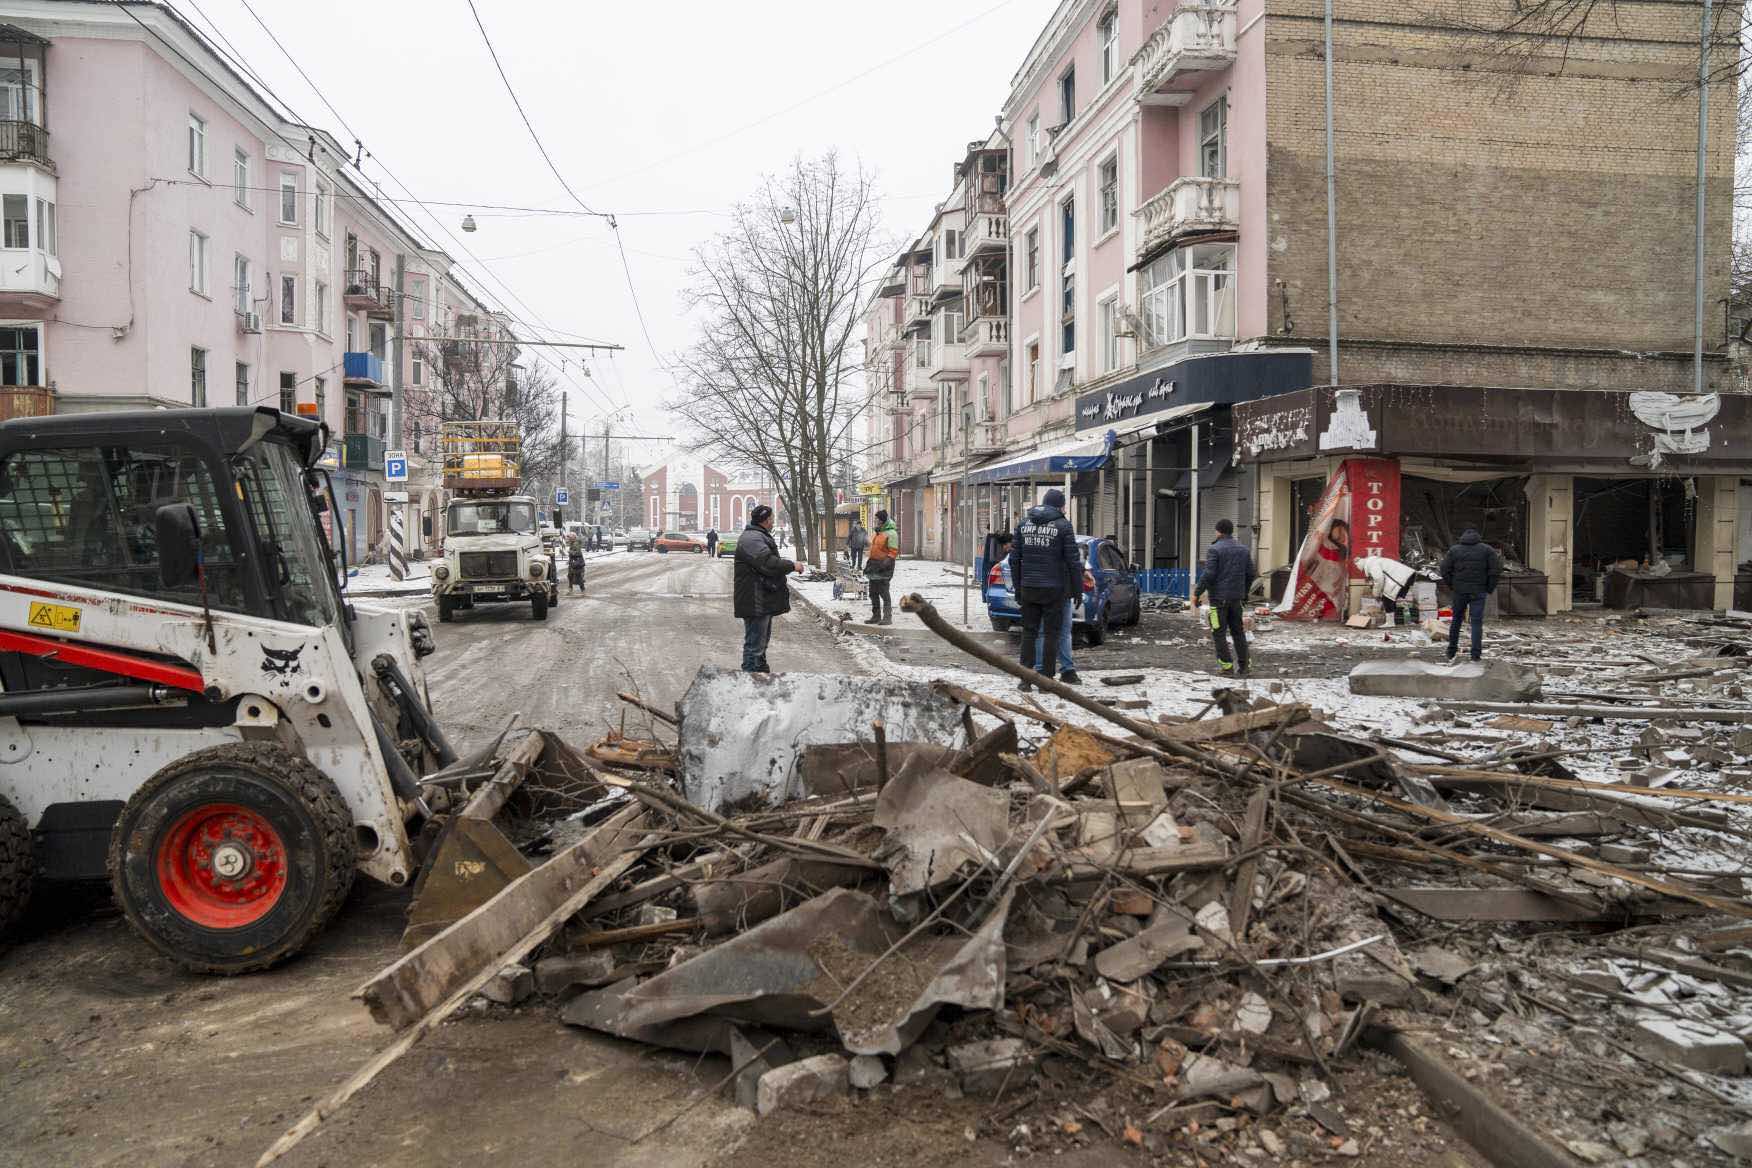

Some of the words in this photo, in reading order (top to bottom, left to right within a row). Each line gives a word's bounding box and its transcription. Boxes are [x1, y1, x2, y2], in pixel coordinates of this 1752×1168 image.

[392, 463, 401, 475] P
[1021, 525, 1036, 533] CAMP
[1038, 527, 1058, 537] DAVID
